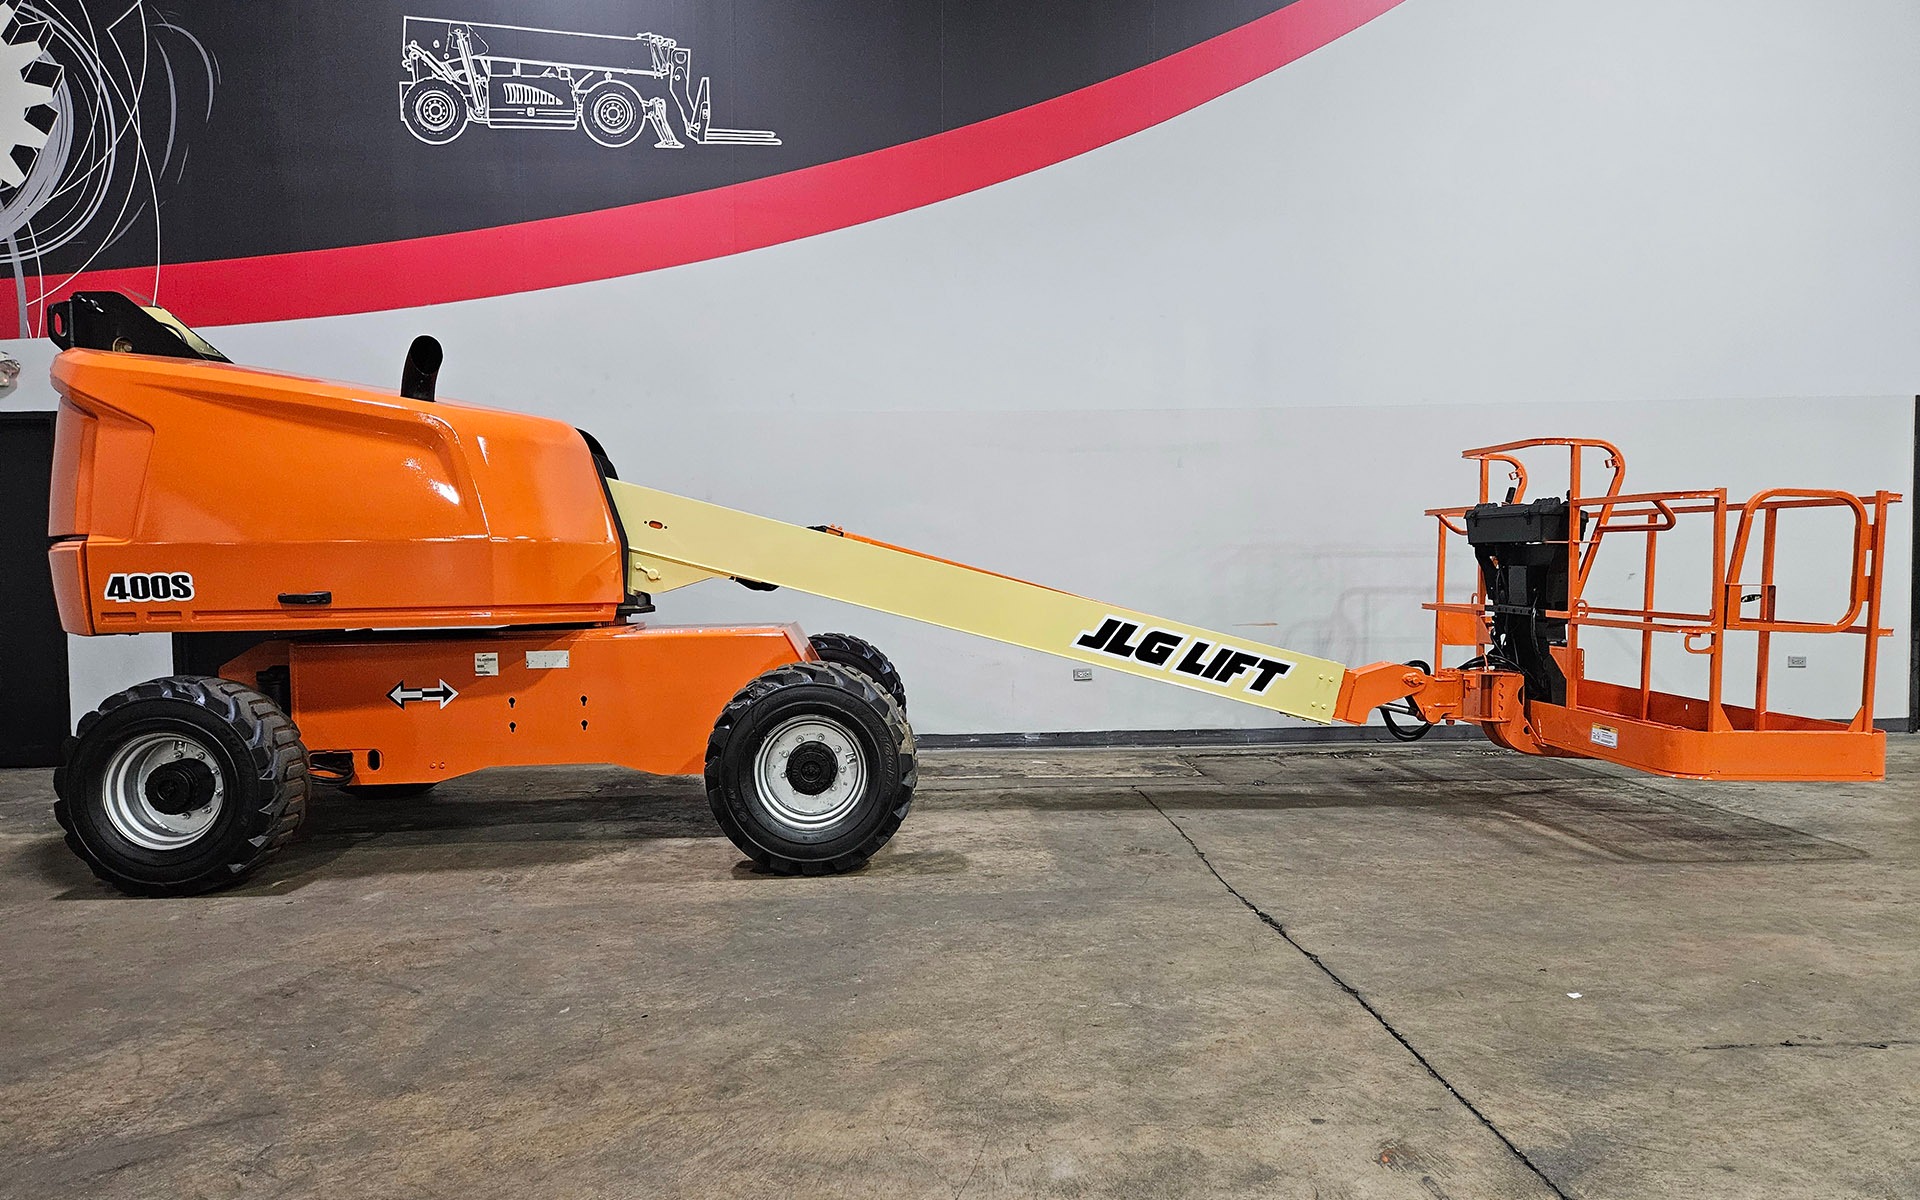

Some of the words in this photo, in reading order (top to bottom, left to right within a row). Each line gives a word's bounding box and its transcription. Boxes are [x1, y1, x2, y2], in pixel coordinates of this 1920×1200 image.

[105, 573, 194, 601] 400S
[1075, 617, 1185, 667] JLG
[1174, 640, 1292, 693] LIFT
